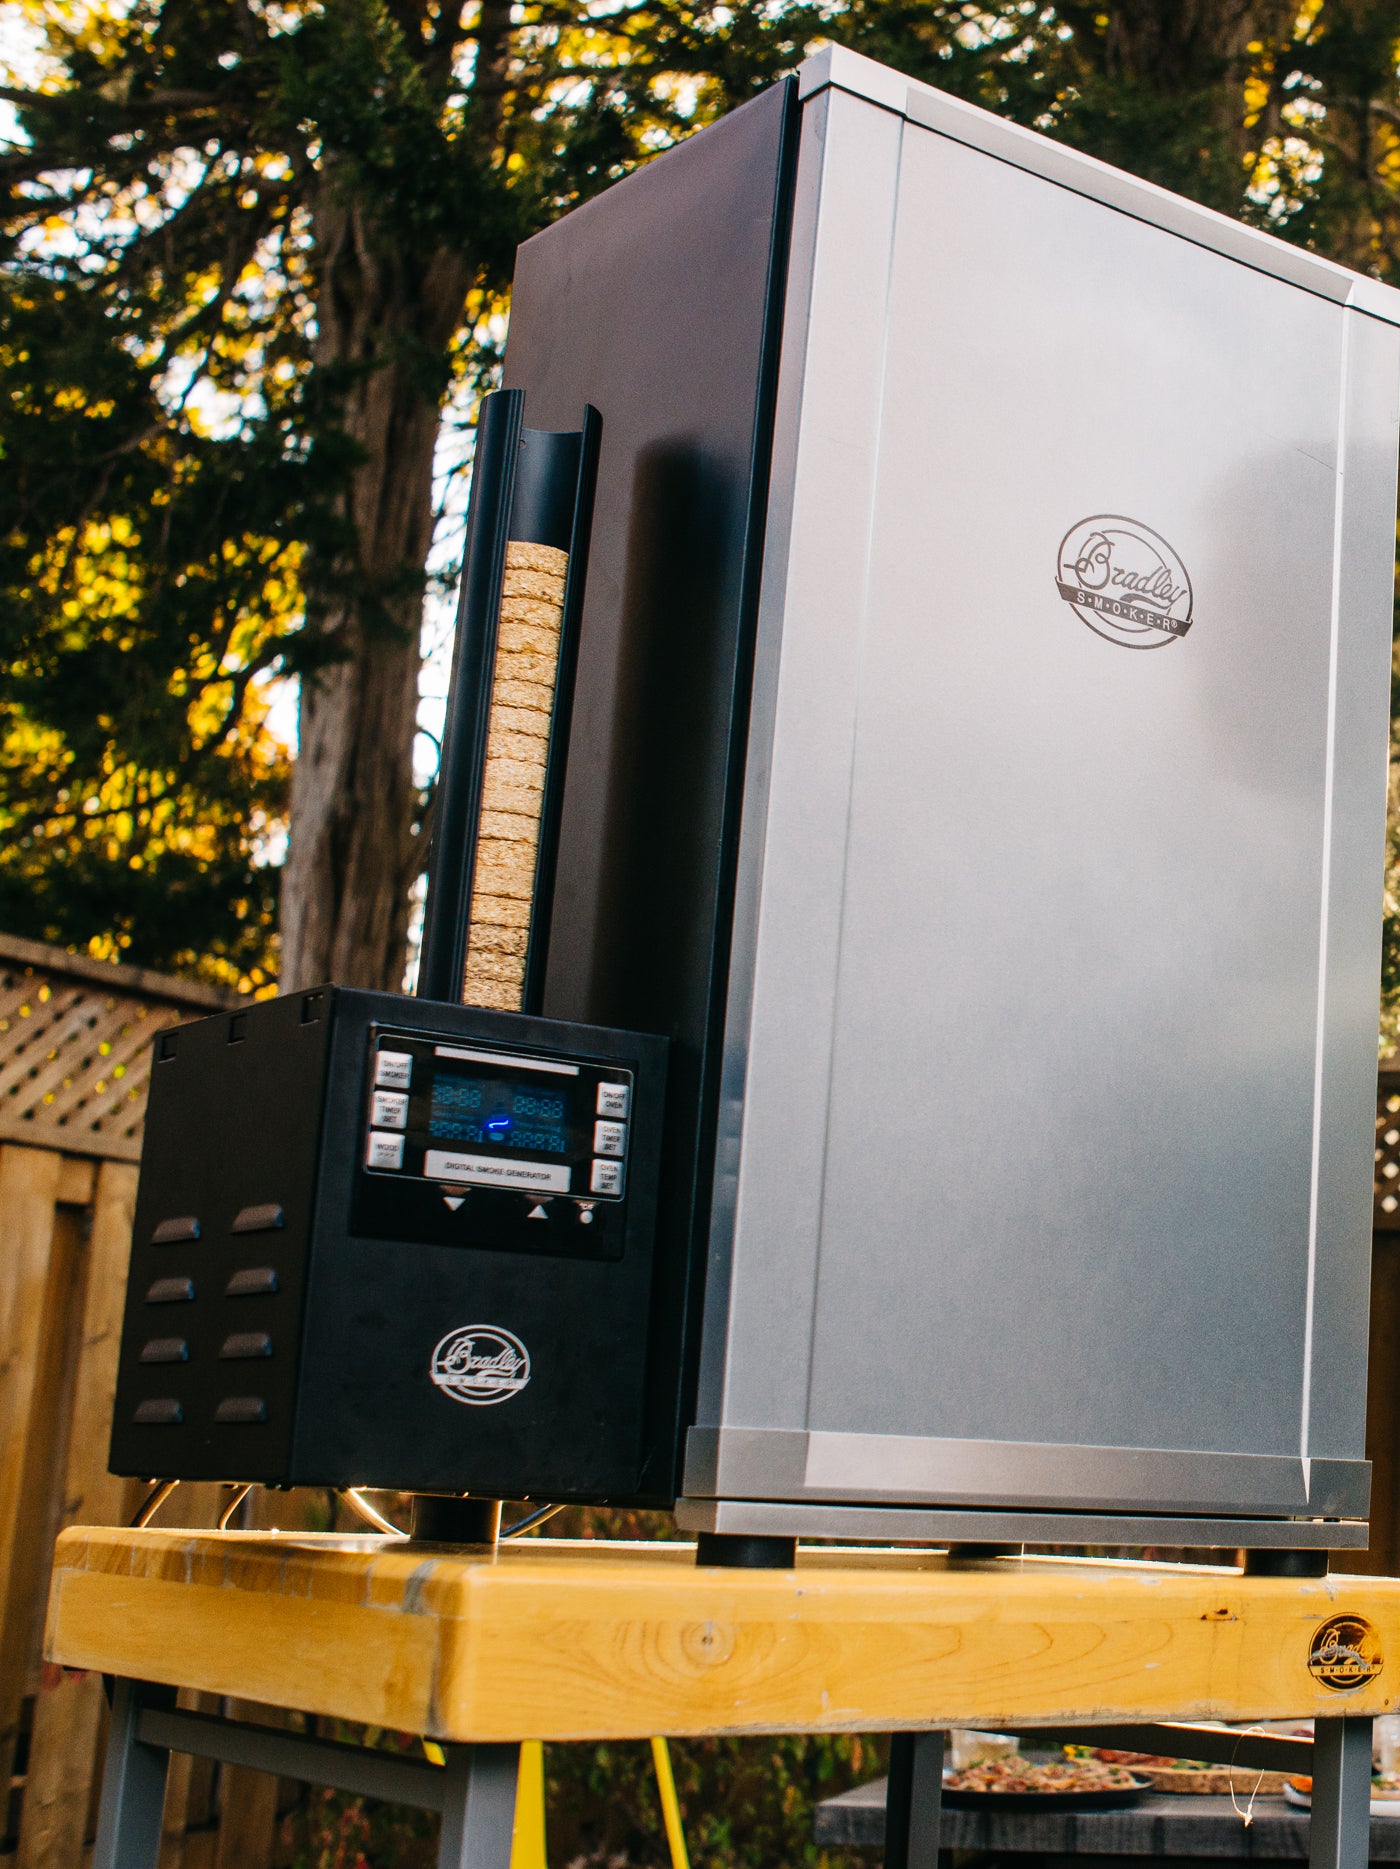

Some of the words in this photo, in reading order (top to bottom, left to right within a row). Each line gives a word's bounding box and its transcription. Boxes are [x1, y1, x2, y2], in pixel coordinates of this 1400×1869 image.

[1063, 531, 1188, 610] Bradley
[381, 1070, 409, 1080] SMOKER
[605, 1101, 623, 1109] OVEN
[382, 1115, 397, 1123] SET
[604, 1126, 621, 1134] OVEN
[603, 1134, 621, 1143] TIMER
[376, 1143, 400, 1152] WOOD
[444, 1161, 474, 1172] DIGITAL
[477, 1165, 504, 1176] SMOKE
[505, 1169, 552, 1181] GENERATOR
[601, 1164, 618, 1172] OVEN
[601, 1173, 617, 1181] TEMP
[437, 1338, 527, 1378] Bradley
